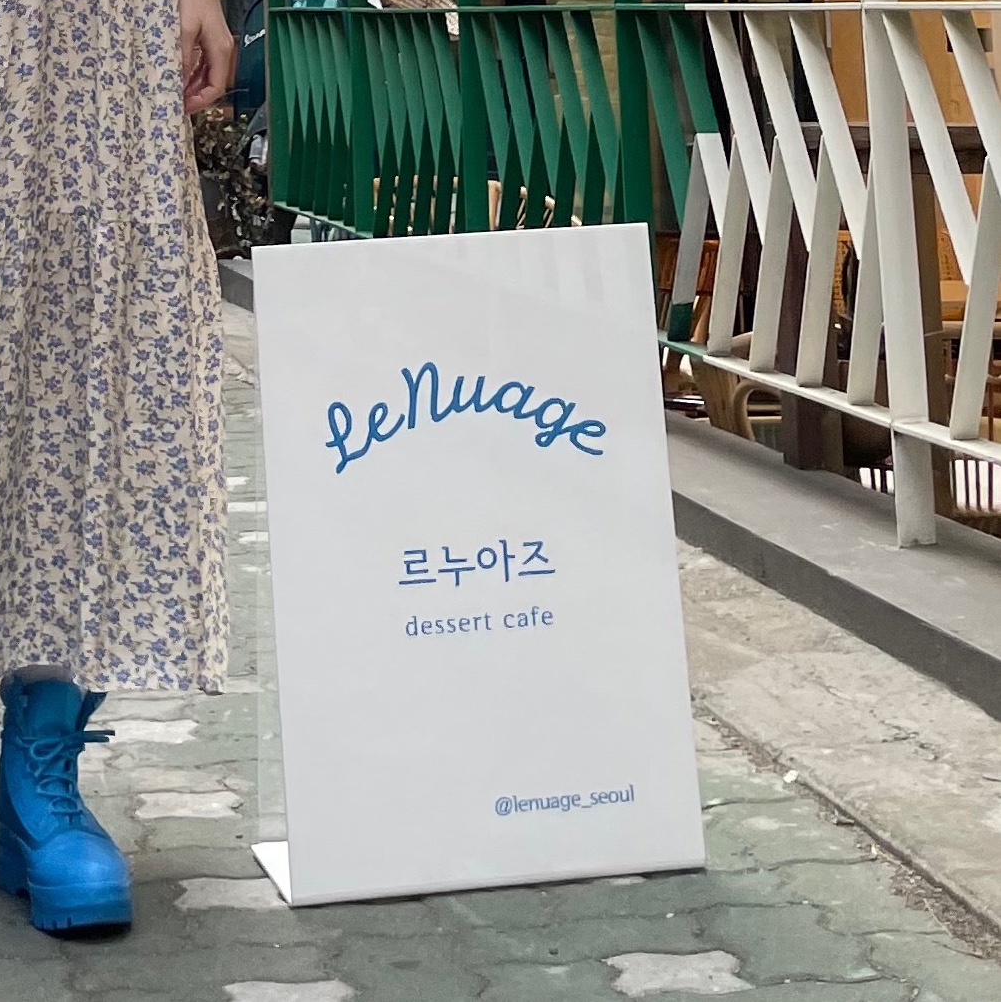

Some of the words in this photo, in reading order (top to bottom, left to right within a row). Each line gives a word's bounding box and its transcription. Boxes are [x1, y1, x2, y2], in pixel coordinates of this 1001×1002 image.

[398, 538, 556, 588] 르누아즈
[404, 611, 493, 638] dessert
[503, 605, 554, 629] cafe
[494, 783, 636, 817] @lenuage_seoul
